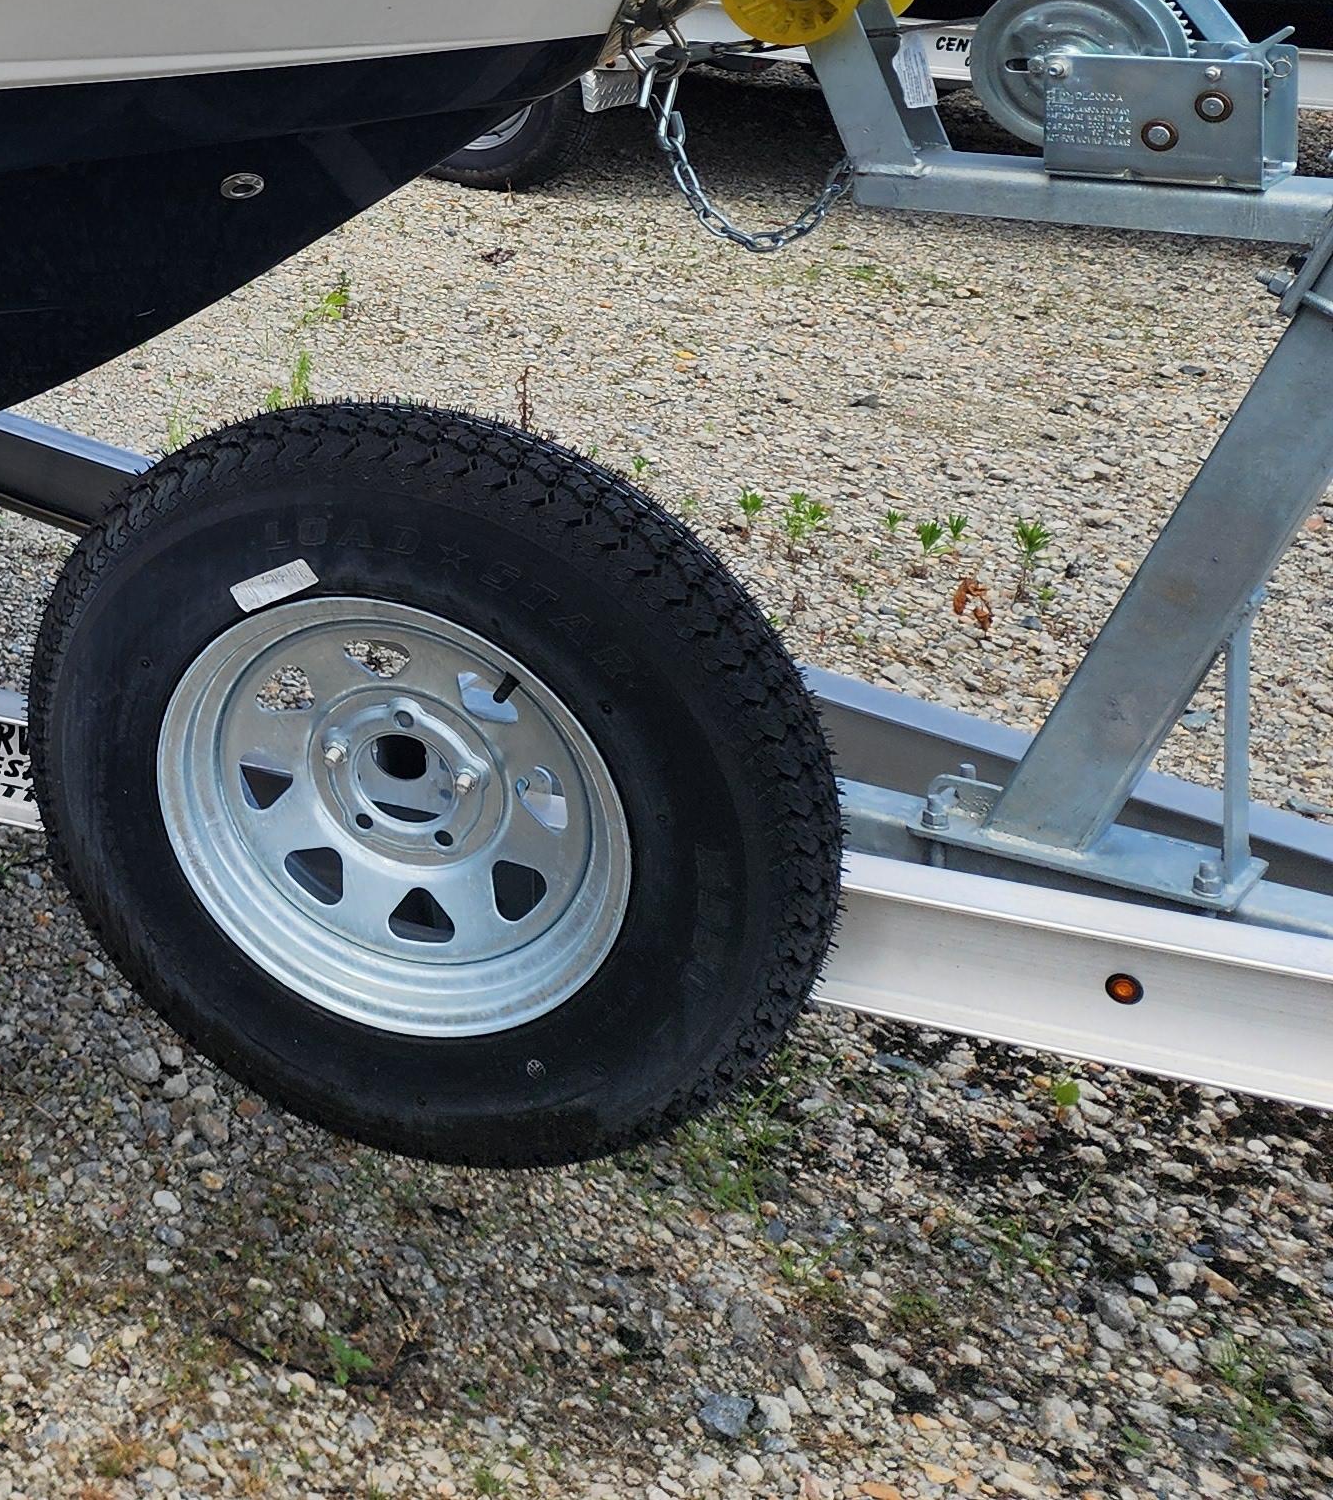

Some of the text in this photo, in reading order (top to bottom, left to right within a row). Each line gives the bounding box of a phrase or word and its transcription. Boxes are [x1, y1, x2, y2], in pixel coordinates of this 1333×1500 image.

[935, 36, 973, 52] CEN
[263, 516, 636, 680] LOAD STAR
